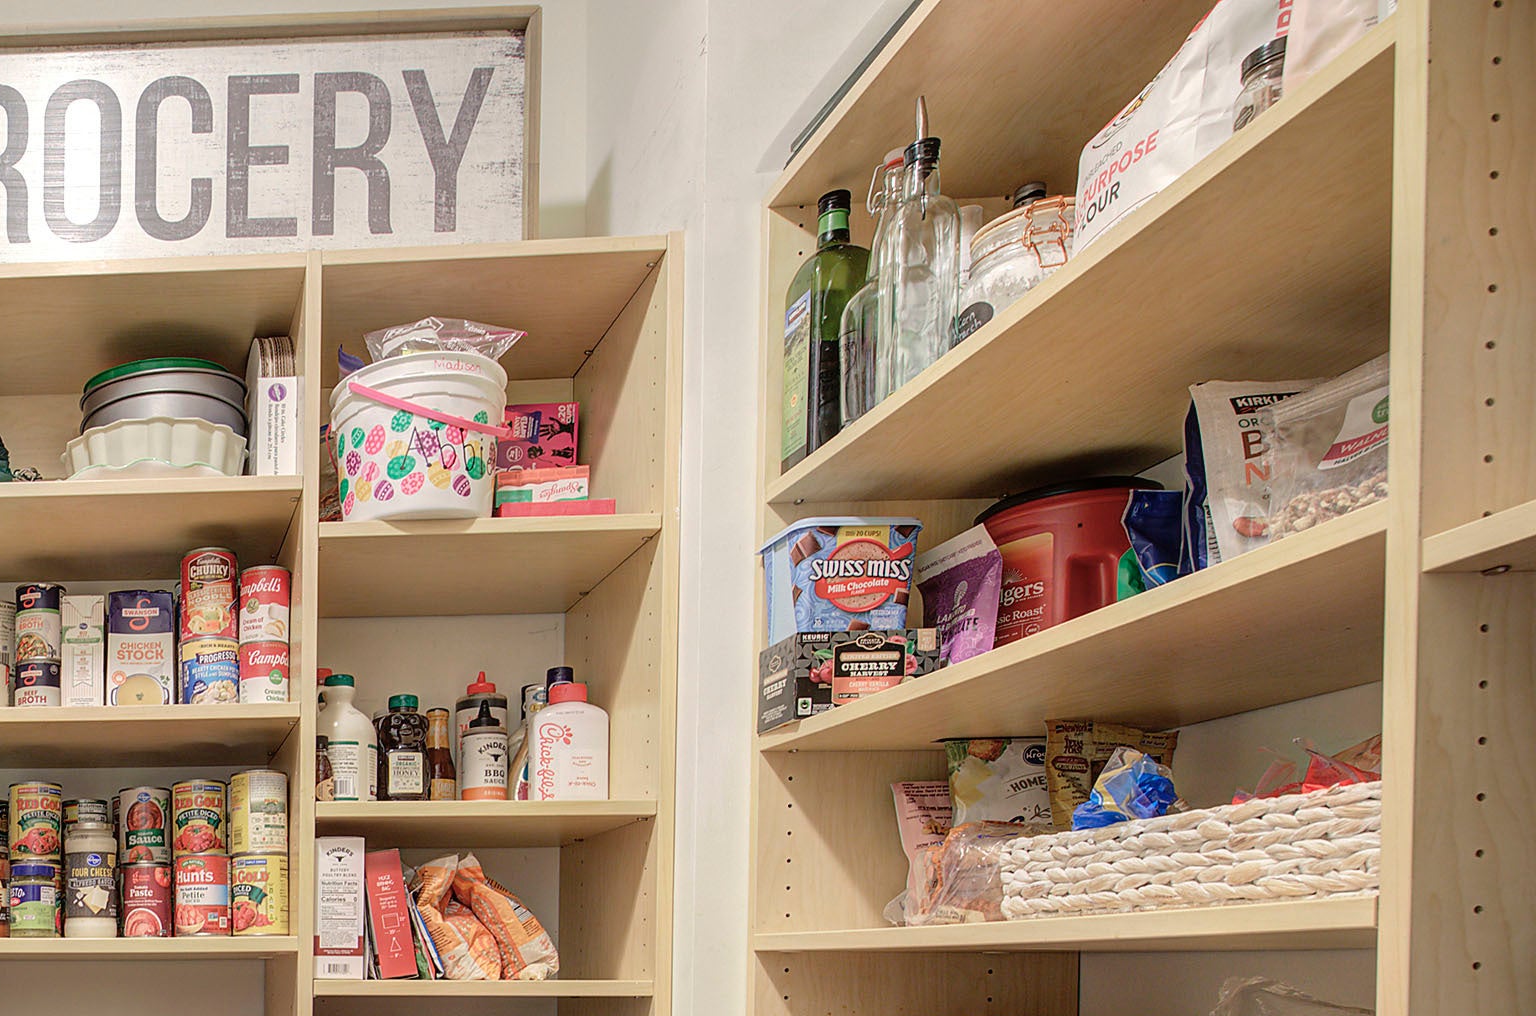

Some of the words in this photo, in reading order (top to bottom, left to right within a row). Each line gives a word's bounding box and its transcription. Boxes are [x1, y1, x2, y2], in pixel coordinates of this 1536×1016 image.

[433, 356, 482, 374] Madison
[190, 564, 229, 578] CHUNKY
[809, 558, 865, 581] SWISS
[827, 583, 847, 594] Milk
[847, 578, 890, 592] Chocolate
[122, 608, 159, 616] SWANSON
[1012, 606, 1044, 620] Roast
[18, 621, 44, 631] BROTH
[119, 641, 162, 650] CHICKEN
[116, 649, 165, 661] STOCK
[198, 651, 236, 664] PROGRESSO
[841, 661, 898, 671] CHERRY
[17, 695, 47, 705] BROTH
[392, 769, 419, 777] HONEY
[484, 769, 505, 778] BBQ
[176, 796, 193, 809] RED
[194, 796, 223, 808] GOLD
[128, 835, 163, 846] Sauce
[71, 867, 90, 877] FOUR
[90, 867, 113, 877] CHEESE
[129, 889, 154, 898] Paste
[181, 891, 206, 900] Petite
